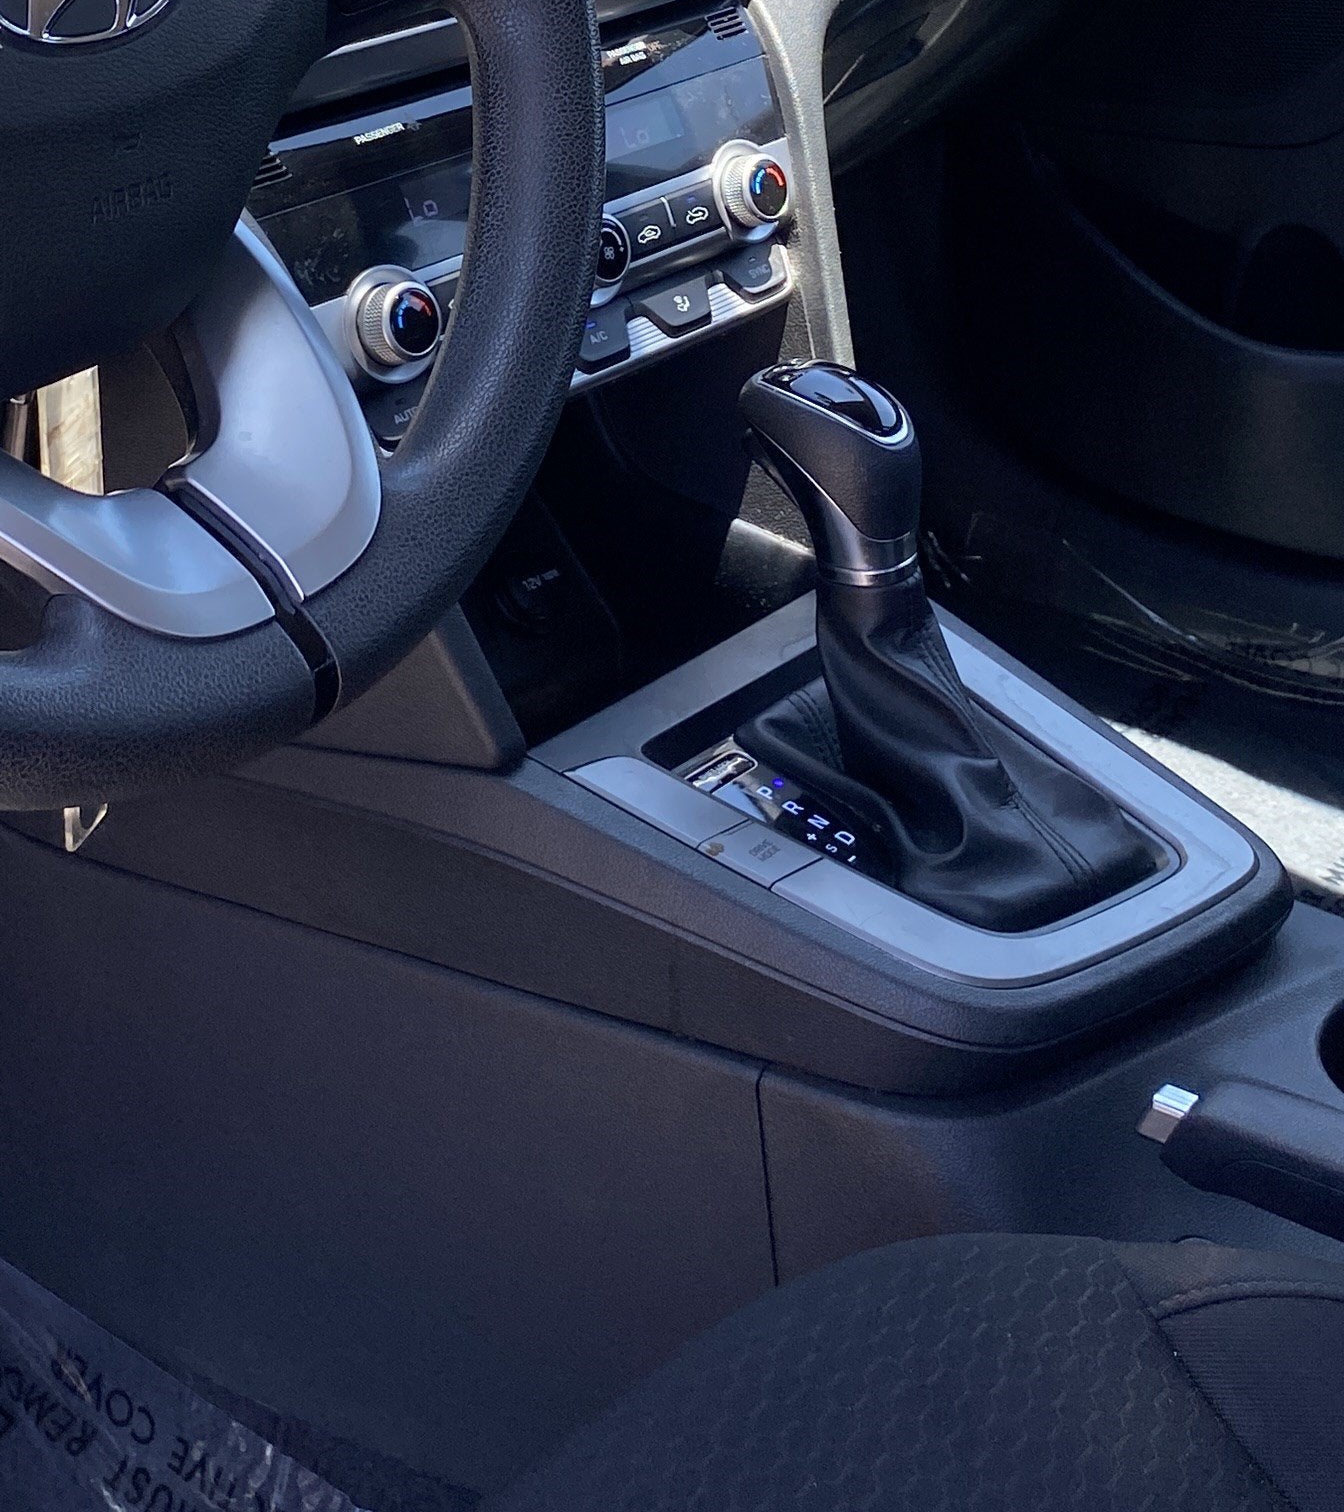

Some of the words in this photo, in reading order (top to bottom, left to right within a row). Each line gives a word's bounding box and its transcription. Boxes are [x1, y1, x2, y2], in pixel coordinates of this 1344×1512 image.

[353, 122, 405, 145] PASSENGER
[748, 263, 770, 279] SYNC
[590, 331, 608, 345] A/C
[394, 406, 419, 425] AUT
[756, 785, 774, 801] P
[781, 800, 804, 815] R
[807, 814, 831, 830] N
[835, 830, 855, 846] D
[825, 843, 838, 853] S
